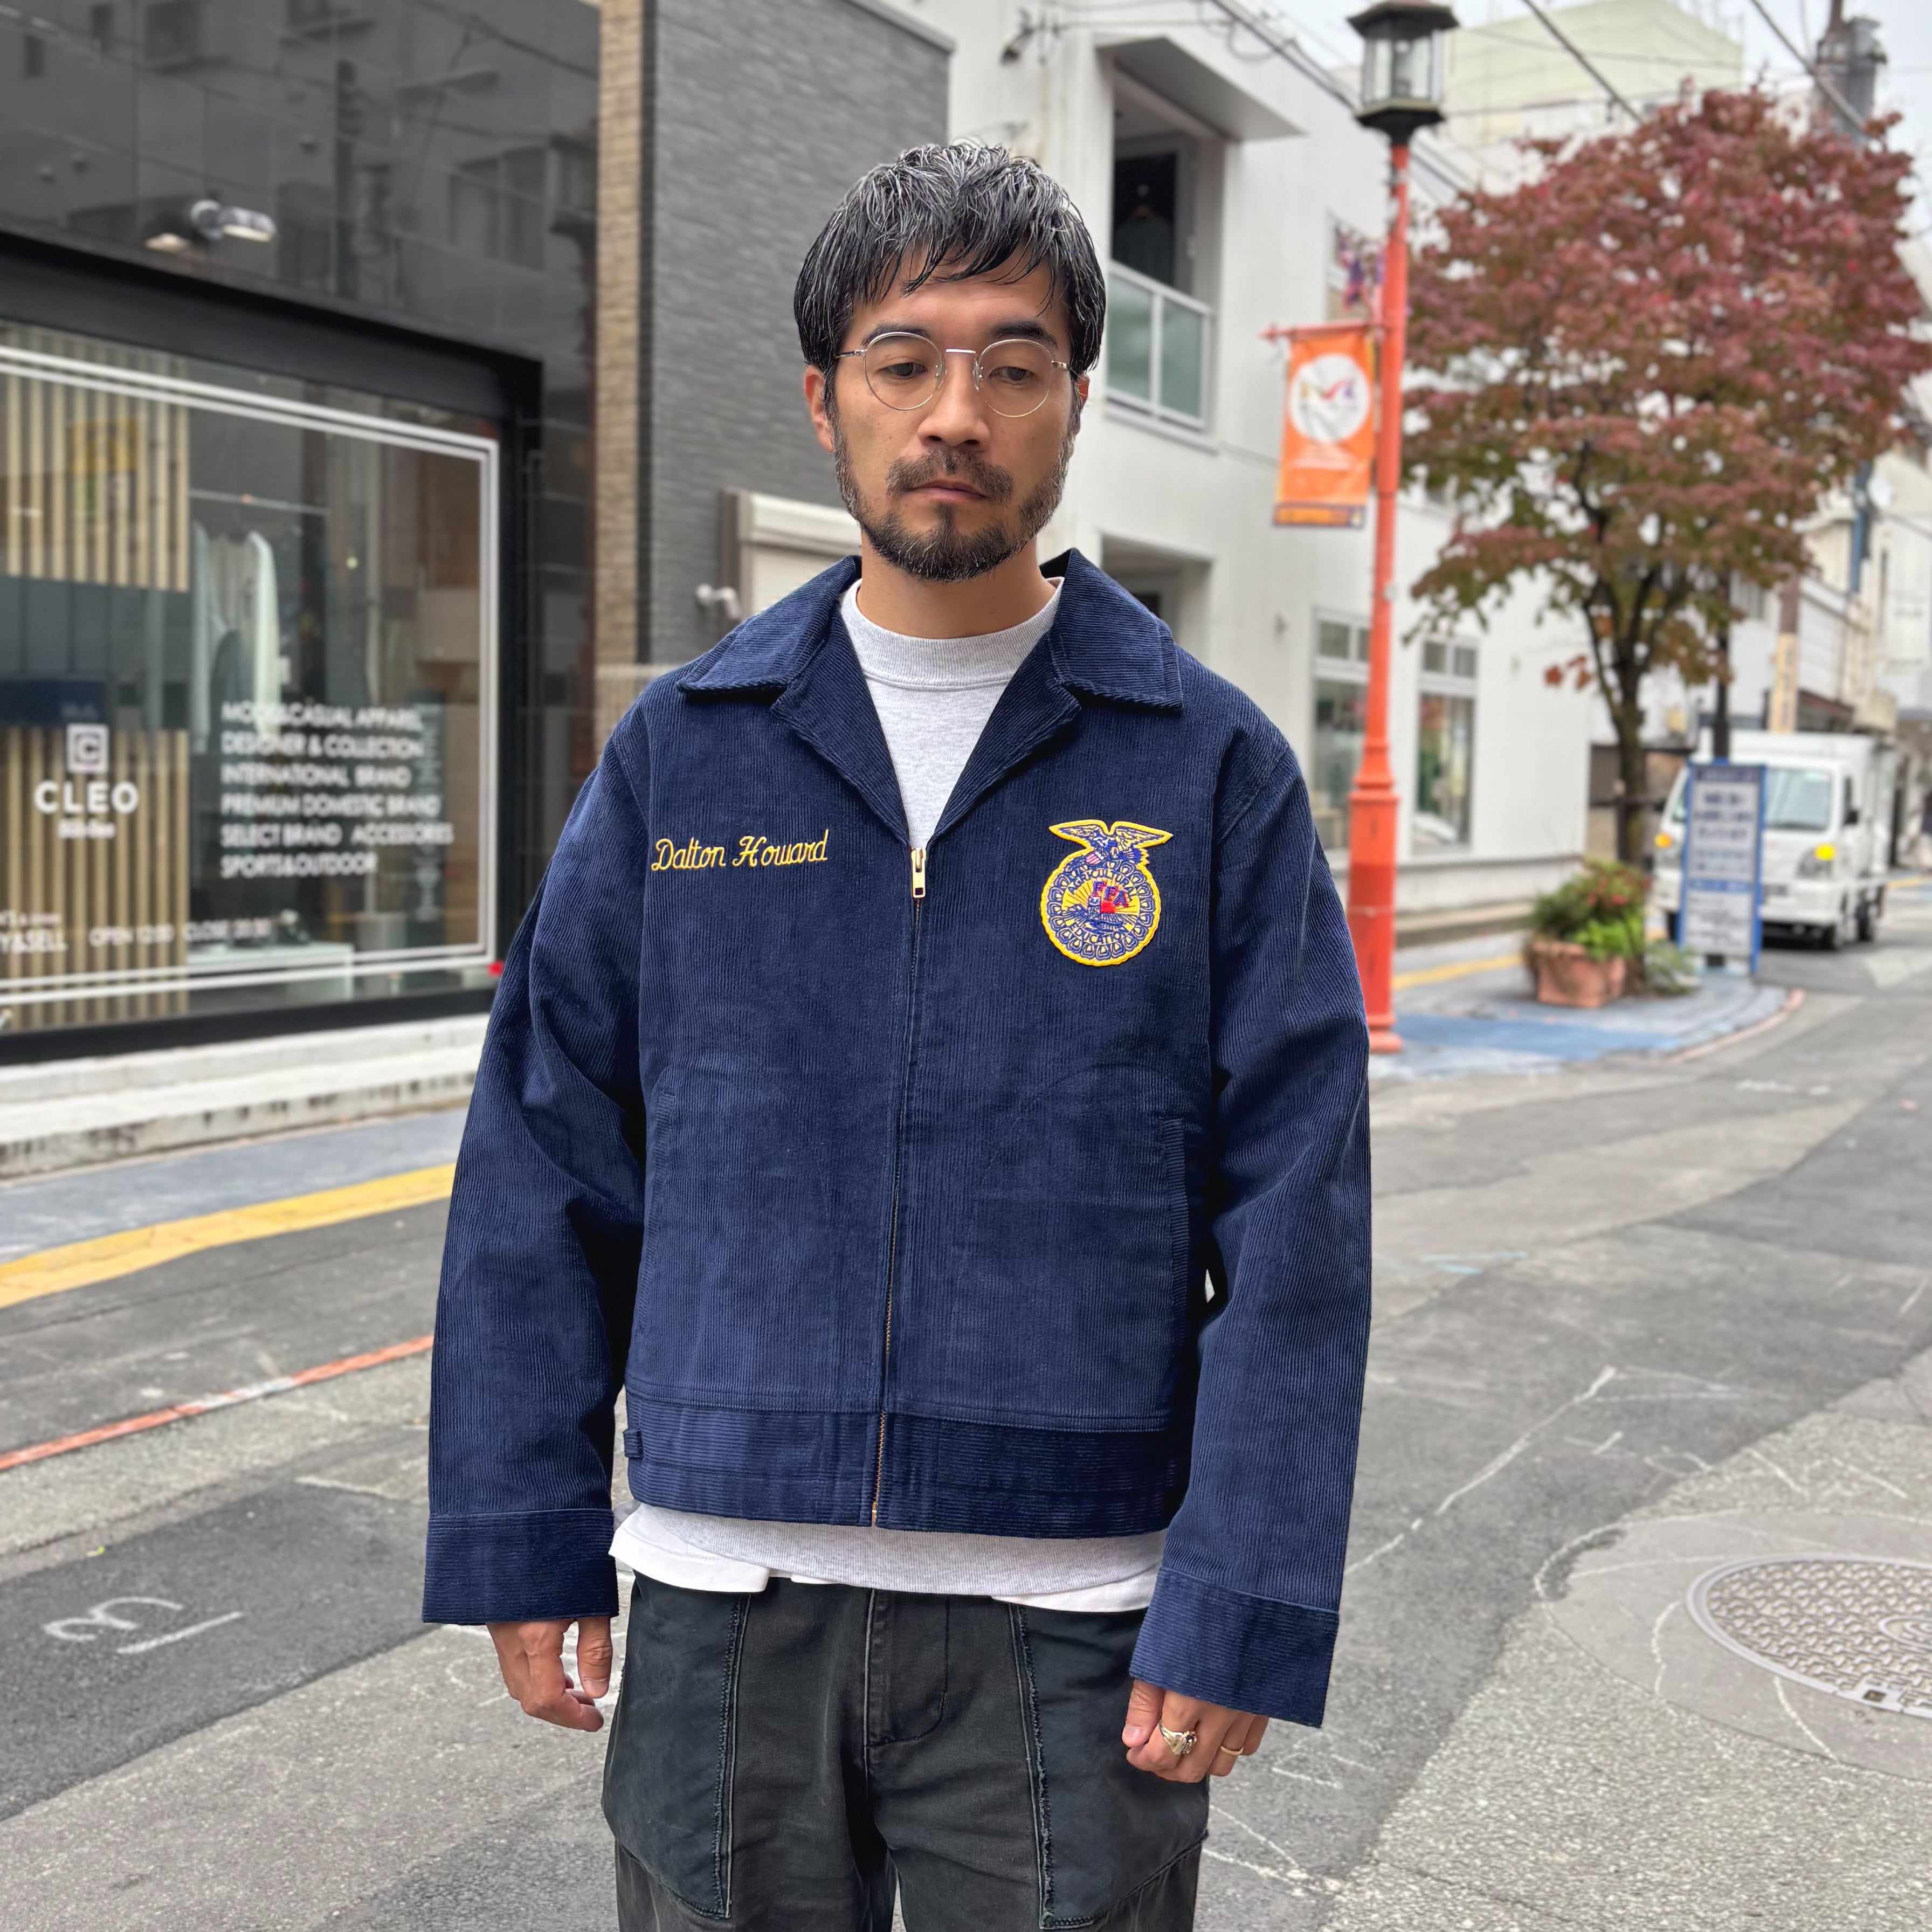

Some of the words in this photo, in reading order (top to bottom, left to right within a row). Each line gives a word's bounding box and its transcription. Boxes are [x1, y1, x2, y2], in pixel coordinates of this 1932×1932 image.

[323, 734, 424, 760] COLLECTION
[220, 762, 351, 788] INTERNATIONAL
[354, 764, 412, 789] BRAND
[34, 780, 139, 815] CLEO
[220, 792, 300, 817] PREMIUM
[302, 793, 385, 817] DOMESTIC
[387, 793, 442, 817] BRAND
[220, 823, 281, 847] SELECT
[282, 823, 343, 847] BRAND
[651, 837, 726, 871] Dalton
[732, 829, 829, 868] Howard
[1093, 880, 1129, 908] FFA
